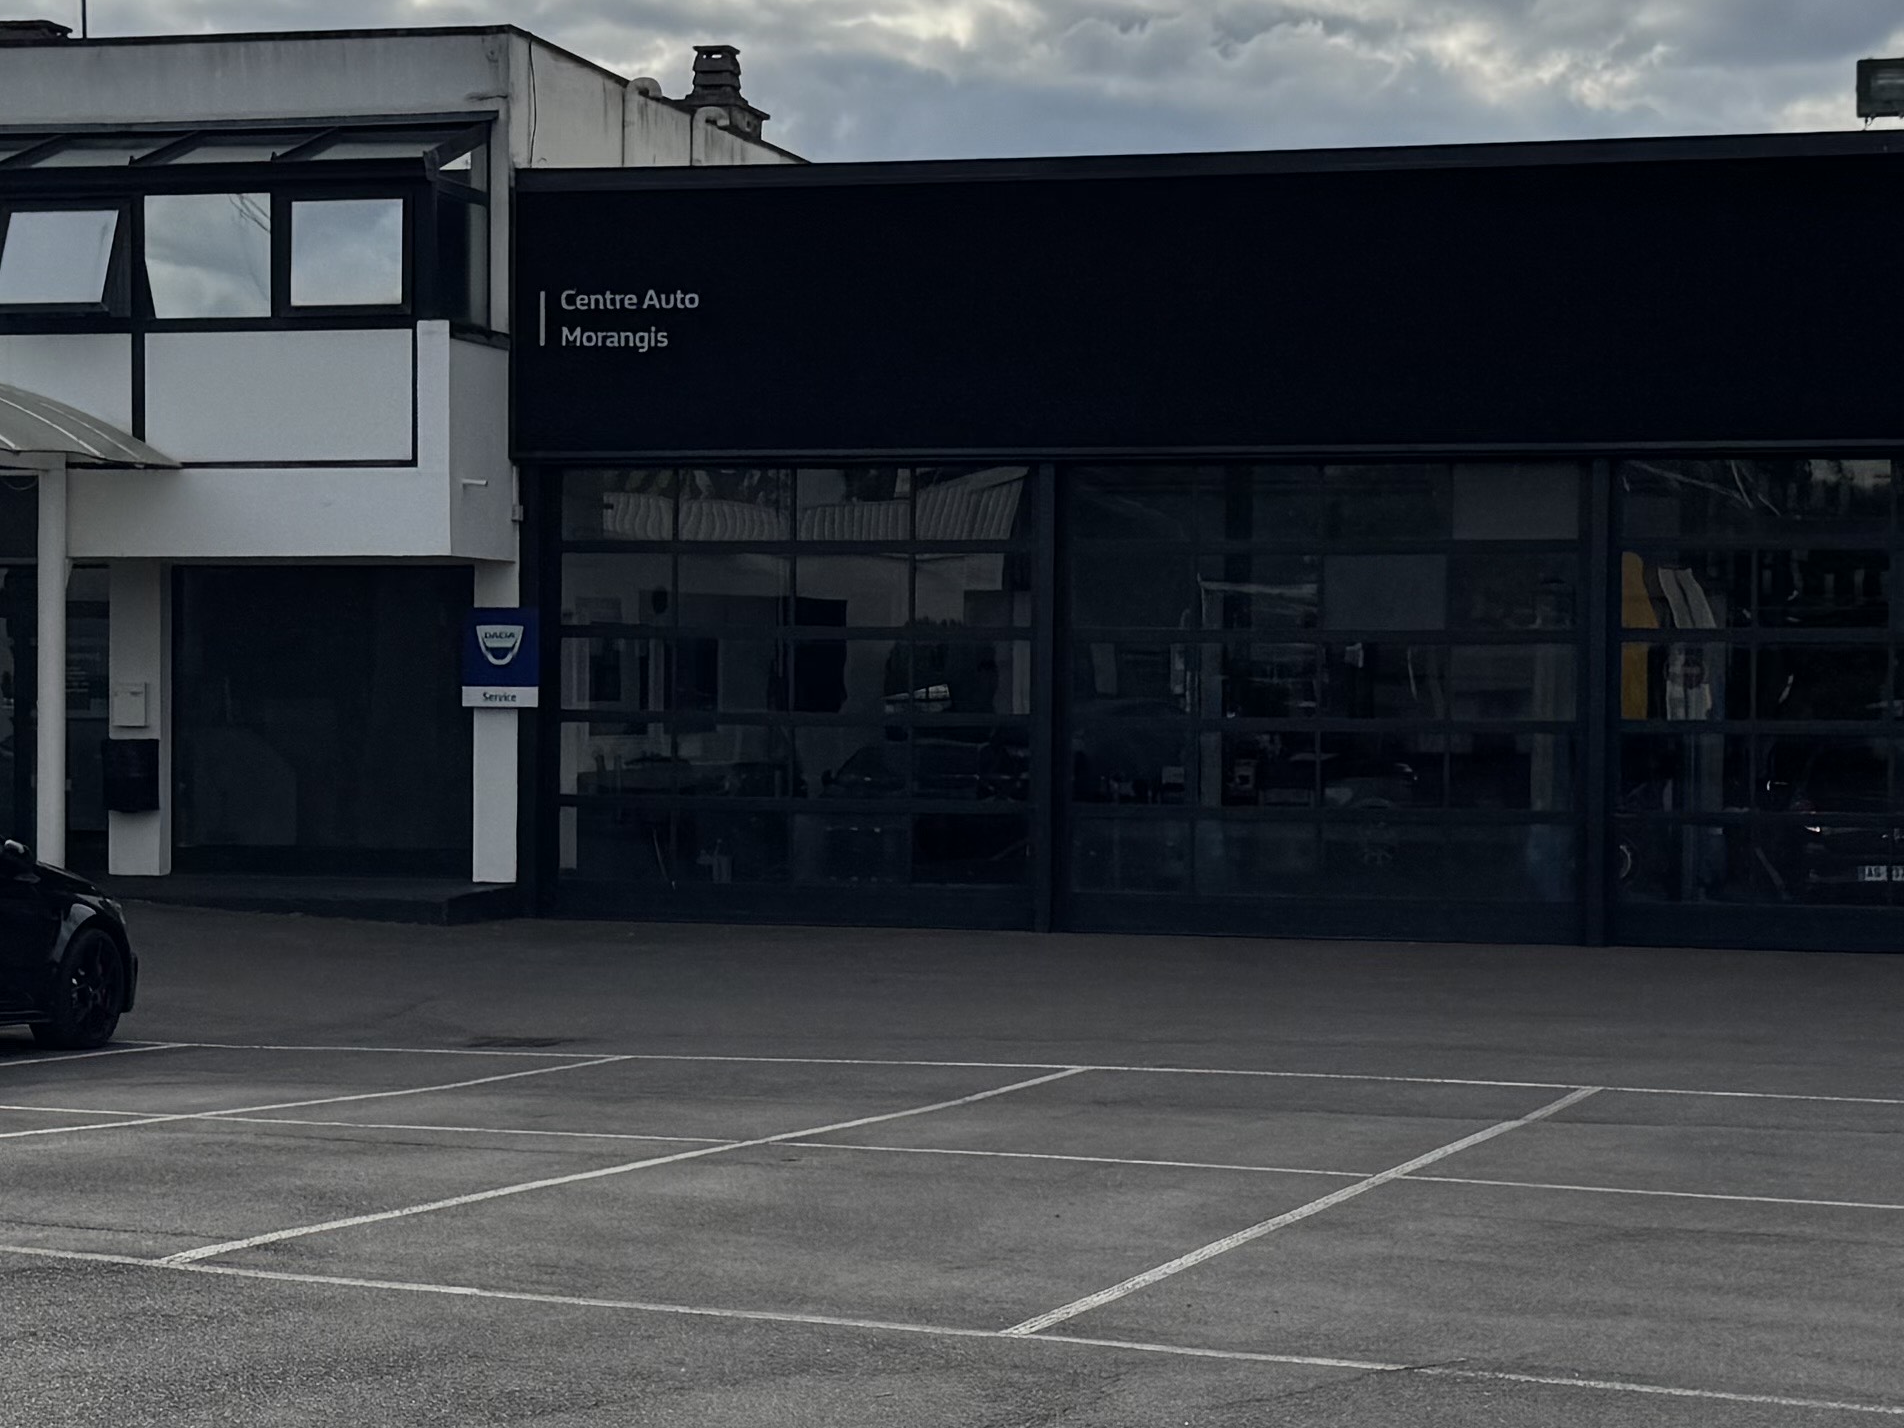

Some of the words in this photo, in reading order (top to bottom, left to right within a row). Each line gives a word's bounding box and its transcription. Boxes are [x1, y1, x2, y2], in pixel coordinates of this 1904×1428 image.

[559, 288, 637, 311] Centre
[643, 288, 701, 310] Auto
[560, 325, 670, 353] Morangis
[484, 632, 516, 640] DACIA
[482, 691, 517, 703] Service
